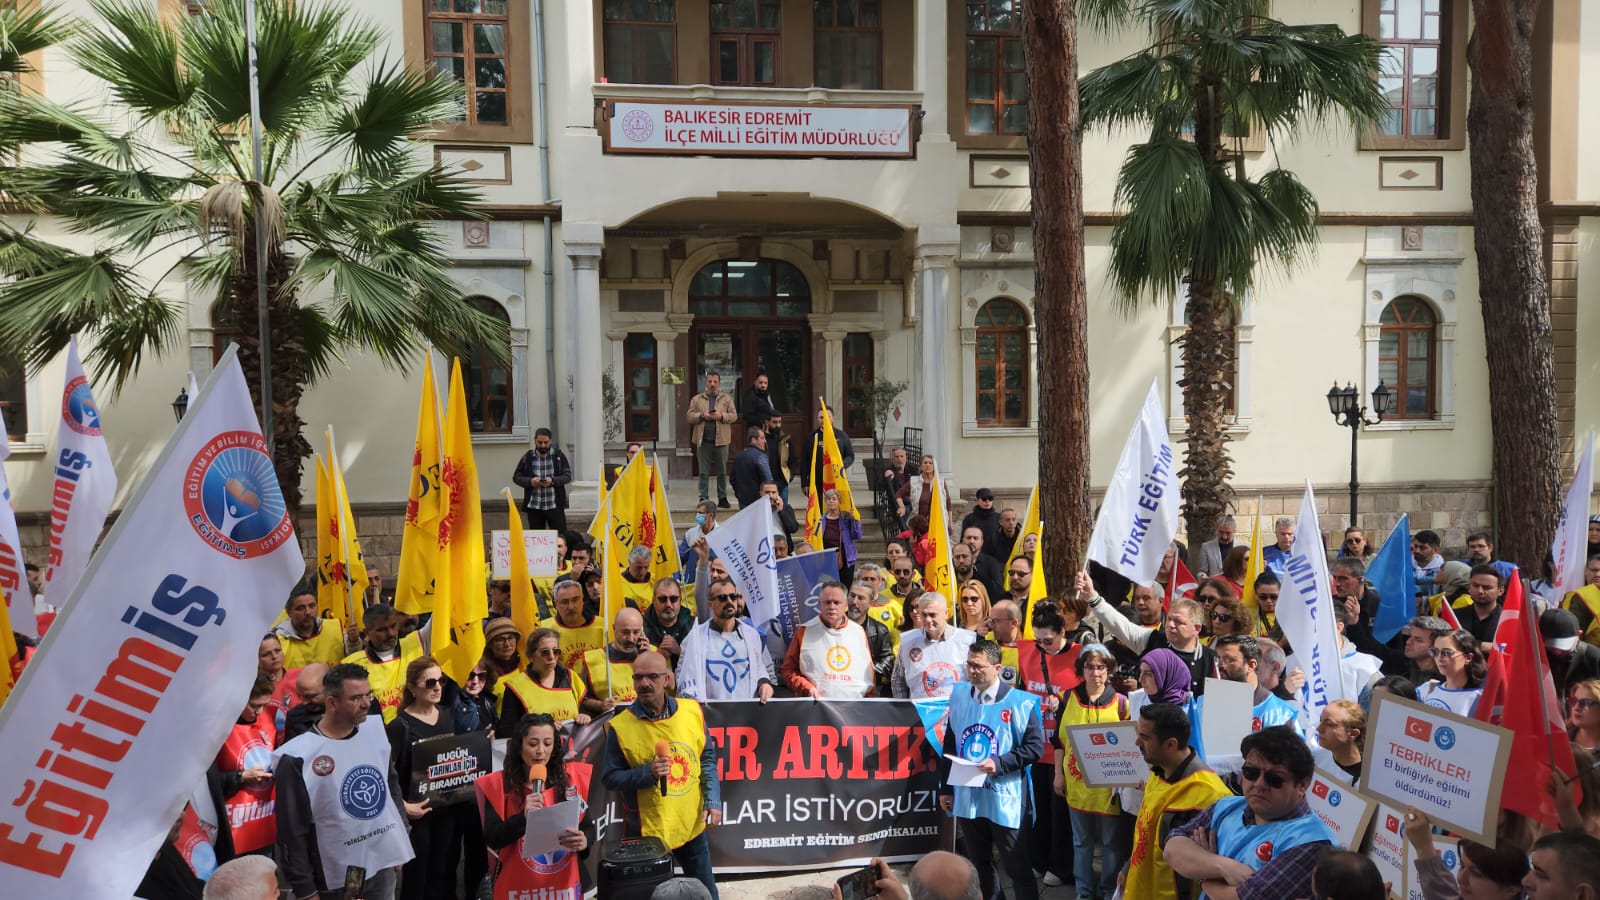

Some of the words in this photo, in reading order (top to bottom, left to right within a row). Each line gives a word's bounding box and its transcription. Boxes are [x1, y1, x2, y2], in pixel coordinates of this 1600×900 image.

[664, 107, 741, 125] BALIKESİR
[745, 109, 812, 126] EDREMİT
[664, 128, 697, 147] İLÇE
[700, 128, 741, 144] MİLLİ
[745, 129, 798, 146] EĞİTİM
[802, 128, 900, 146] MÜDÜRLÜĞÜ
[188, 458, 207, 499] EĞİTİM
[205, 445, 217, 457] VE
[1120, 511, 1153, 567] TÜRK
[1138, 444, 1173, 513] EĞİTİM
[437, 747, 469, 763] BUGÜN
[1389, 742, 1471, 783] TEBRİKLER!
[428, 759, 462, 779] YARINLAR
[1384, 758, 1393, 769] El
[1395, 762, 1435, 785] birliğiyle
[1436, 780, 1471, 800] eğitimi
[418, 781, 428, 795] İŞ
[1395, 779, 1452, 809] öldürdünüz!
[786, 790, 938, 822] İSTİYORUZ!
[744, 833, 804, 849] EDREMİT
[807, 832, 855, 847] EĞİTİM
[857, 826, 939, 844] SENDİKALARI
